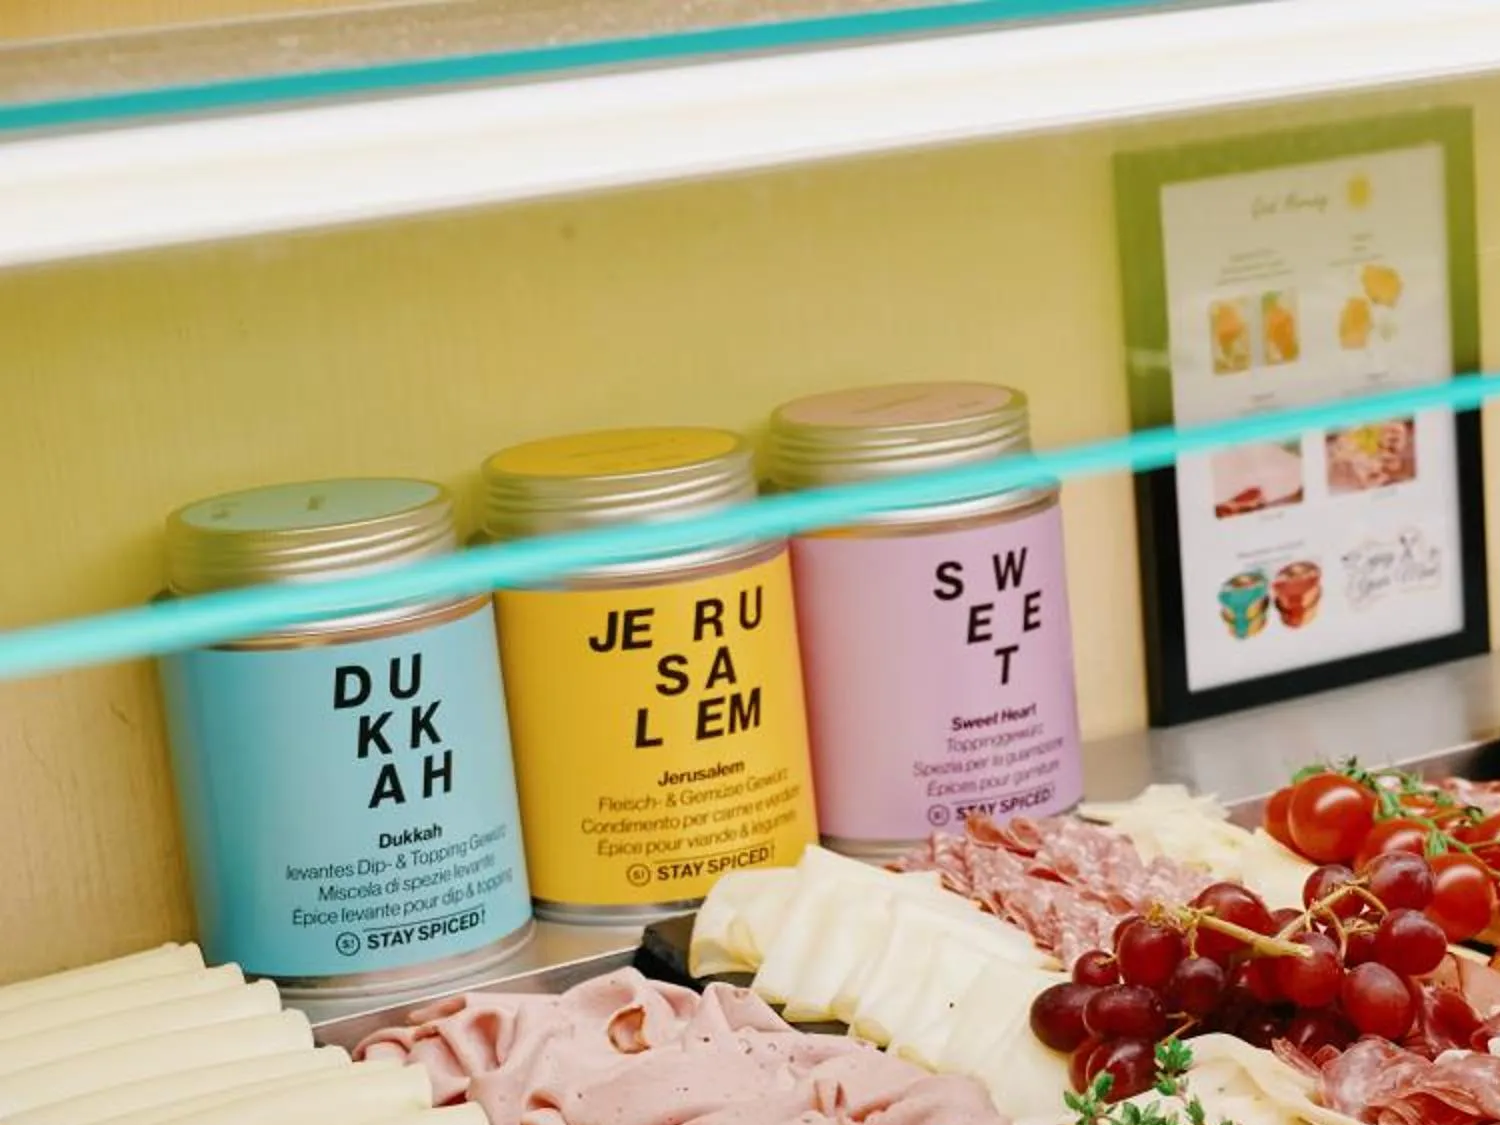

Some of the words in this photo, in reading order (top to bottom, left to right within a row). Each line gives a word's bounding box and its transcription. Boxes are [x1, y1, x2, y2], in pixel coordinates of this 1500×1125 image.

[994, 644, 1019, 686] T
[951, 711, 999, 732] Sweet
[1001, 702, 1037, 723] Heart
[657, 760, 745, 787] Jerusalem
[979, 773, 1010, 792] pour
[598, 796, 658, 813] Fleisch-
[665, 795, 677, 808] &
[680, 783, 744, 806] Gemüse
[955, 802, 997, 821] STAY
[581, 815, 681, 835] Condimento
[682, 811, 709, 831] per
[713, 802, 753, 823] carne
[379, 823, 442, 849] Dukkah
[645, 836, 684, 855] pour
[686, 827, 737, 849] viande
[739, 823, 749, 839] &
[286, 864, 354, 881] levantes
[357, 859, 392, 877] Dip-
[395, 854, 406, 869] &
[411, 840, 467, 865] Topping
[657, 861, 706, 882] STAY
[708, 842, 775, 874] SPICED!
[318, 882, 382, 902] Miscela
[385, 879, 400, 894] di
[403, 869, 450, 892] spezie
[341, 903, 400, 923] levante
[403, 896, 438, 917] pour
[442, 887, 464, 908] dip
[465, 881, 475, 899] &
[367, 928, 416, 950] STAY
[418, 909, 486, 941] SPICED!
